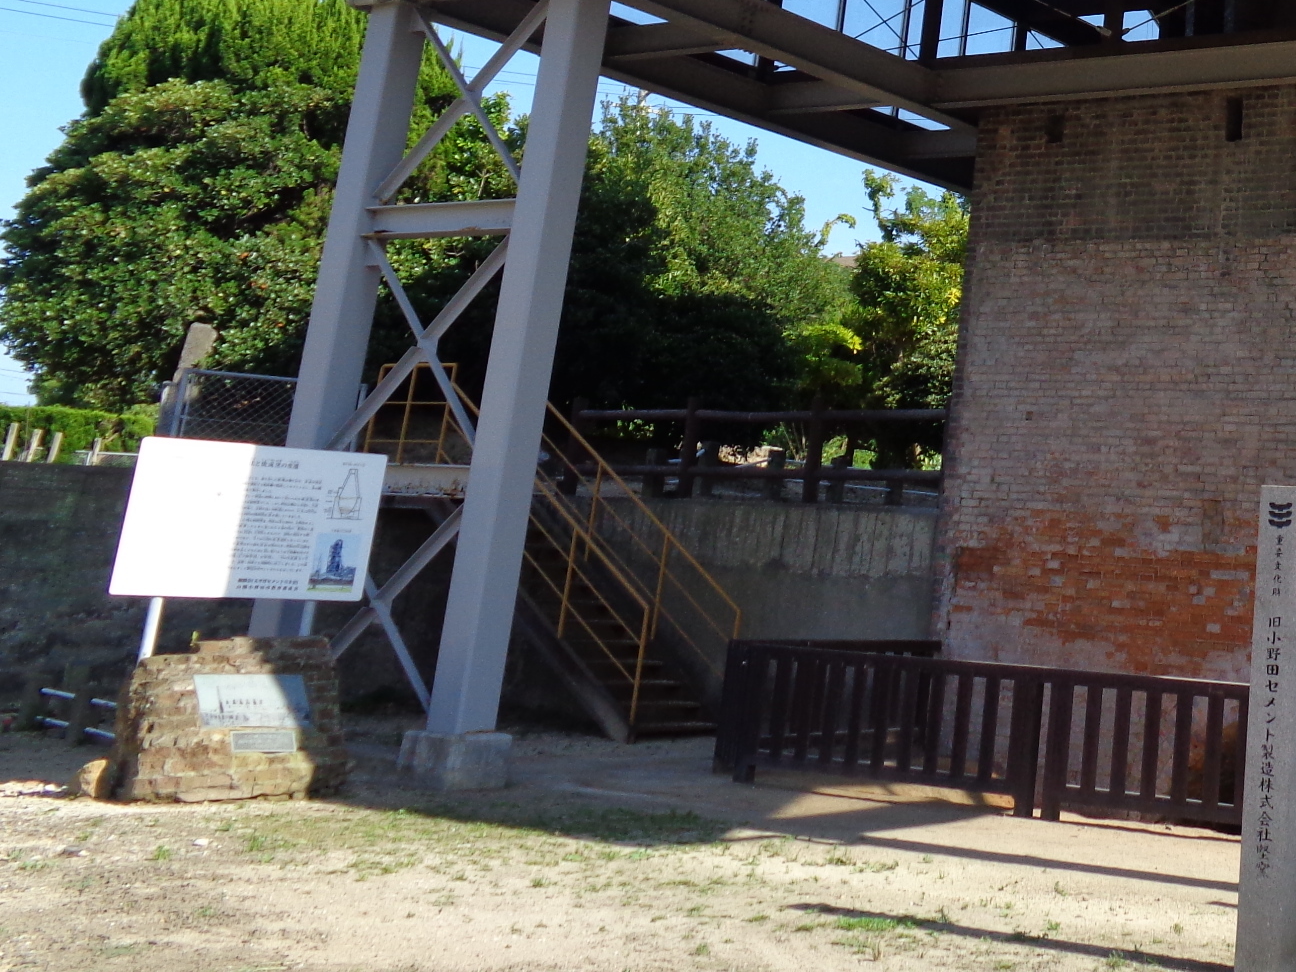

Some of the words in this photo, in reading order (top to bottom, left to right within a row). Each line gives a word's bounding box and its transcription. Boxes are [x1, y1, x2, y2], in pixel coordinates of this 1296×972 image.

[1271, 534, 1284, 597] 重要文化財
